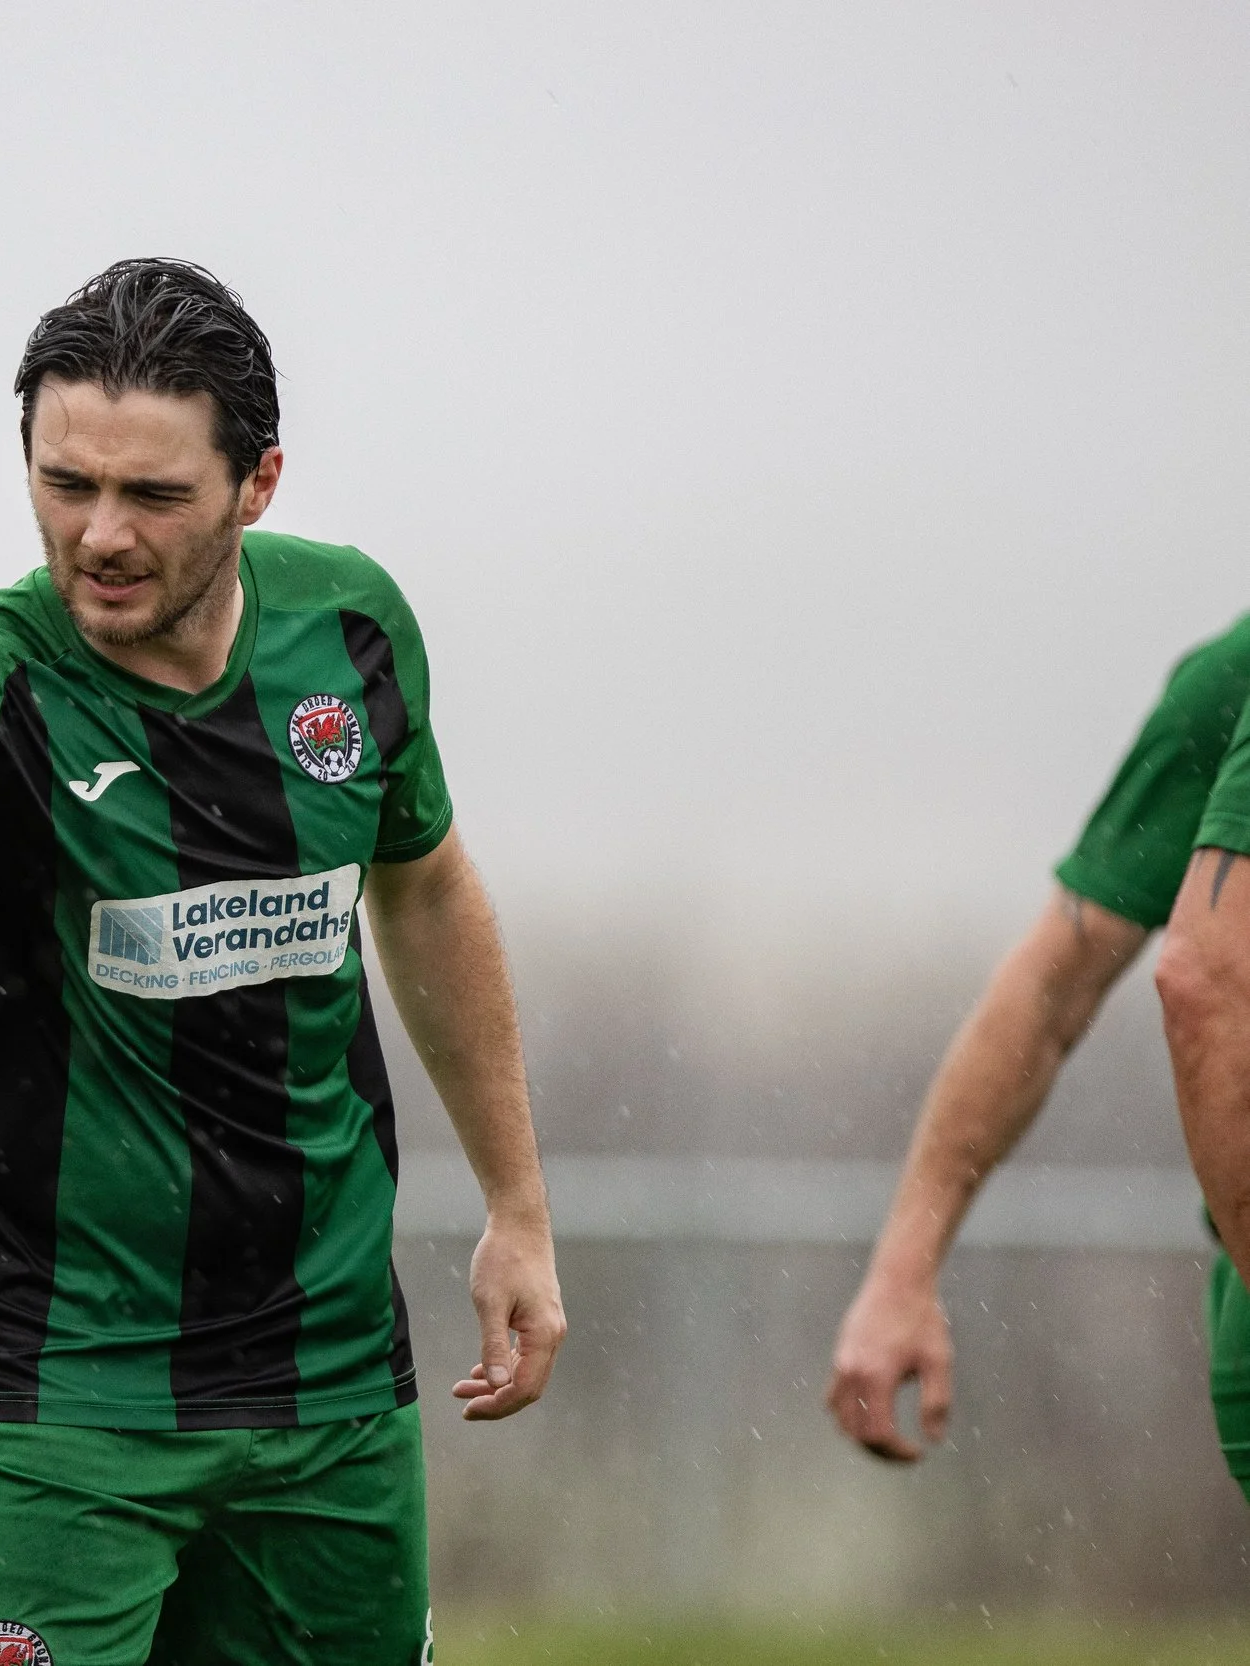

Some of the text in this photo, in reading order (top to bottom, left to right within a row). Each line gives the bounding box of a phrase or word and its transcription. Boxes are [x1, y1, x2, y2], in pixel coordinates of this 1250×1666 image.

[302, 696, 333, 712] DROED
[337, 701, 362, 753] GRONANT
[293, 740, 312, 770] CLWB
[317, 769, 328, 781] 20
[172, 881, 330, 932] Lakeland
[172, 910, 350, 962] Verandahs
[95, 963, 179, 989] DECKING
[189, 959, 260, 986] FENCING
[27, 1634, 50, 1666] GRON
